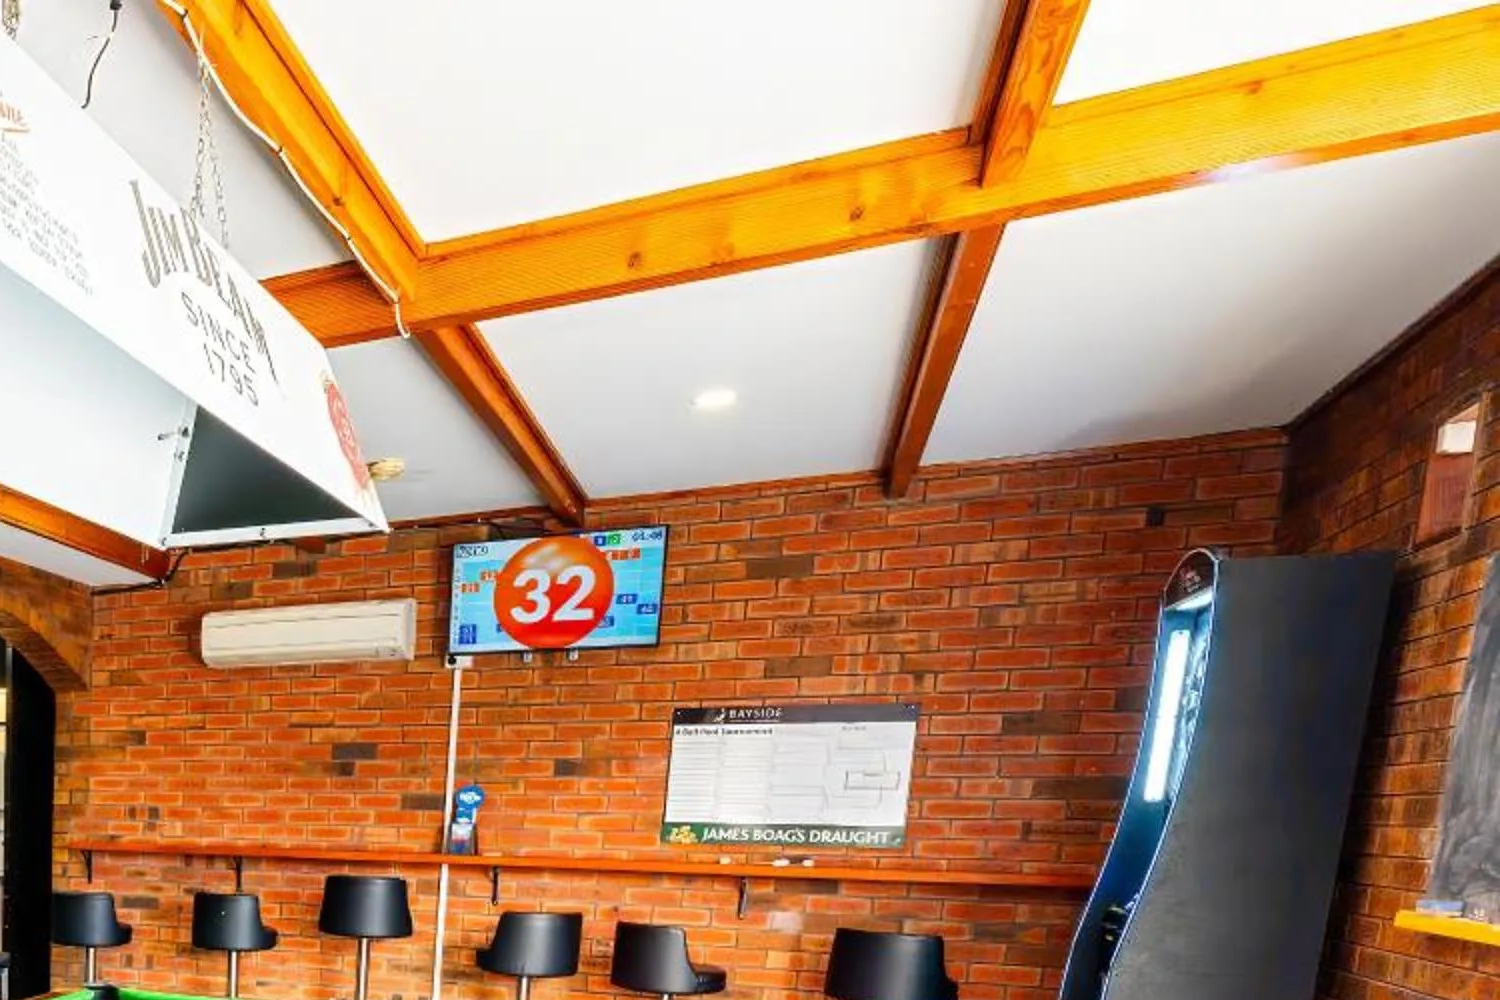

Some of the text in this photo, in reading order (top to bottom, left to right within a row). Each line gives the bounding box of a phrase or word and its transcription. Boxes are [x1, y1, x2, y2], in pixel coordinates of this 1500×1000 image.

[181, 291, 256, 374] SINCE
[203, 343, 260, 407] 1795
[510, 564, 597, 624] 32
[702, 827, 749, 842] JAMES
[809, 829, 890, 844] DRAUGHT
